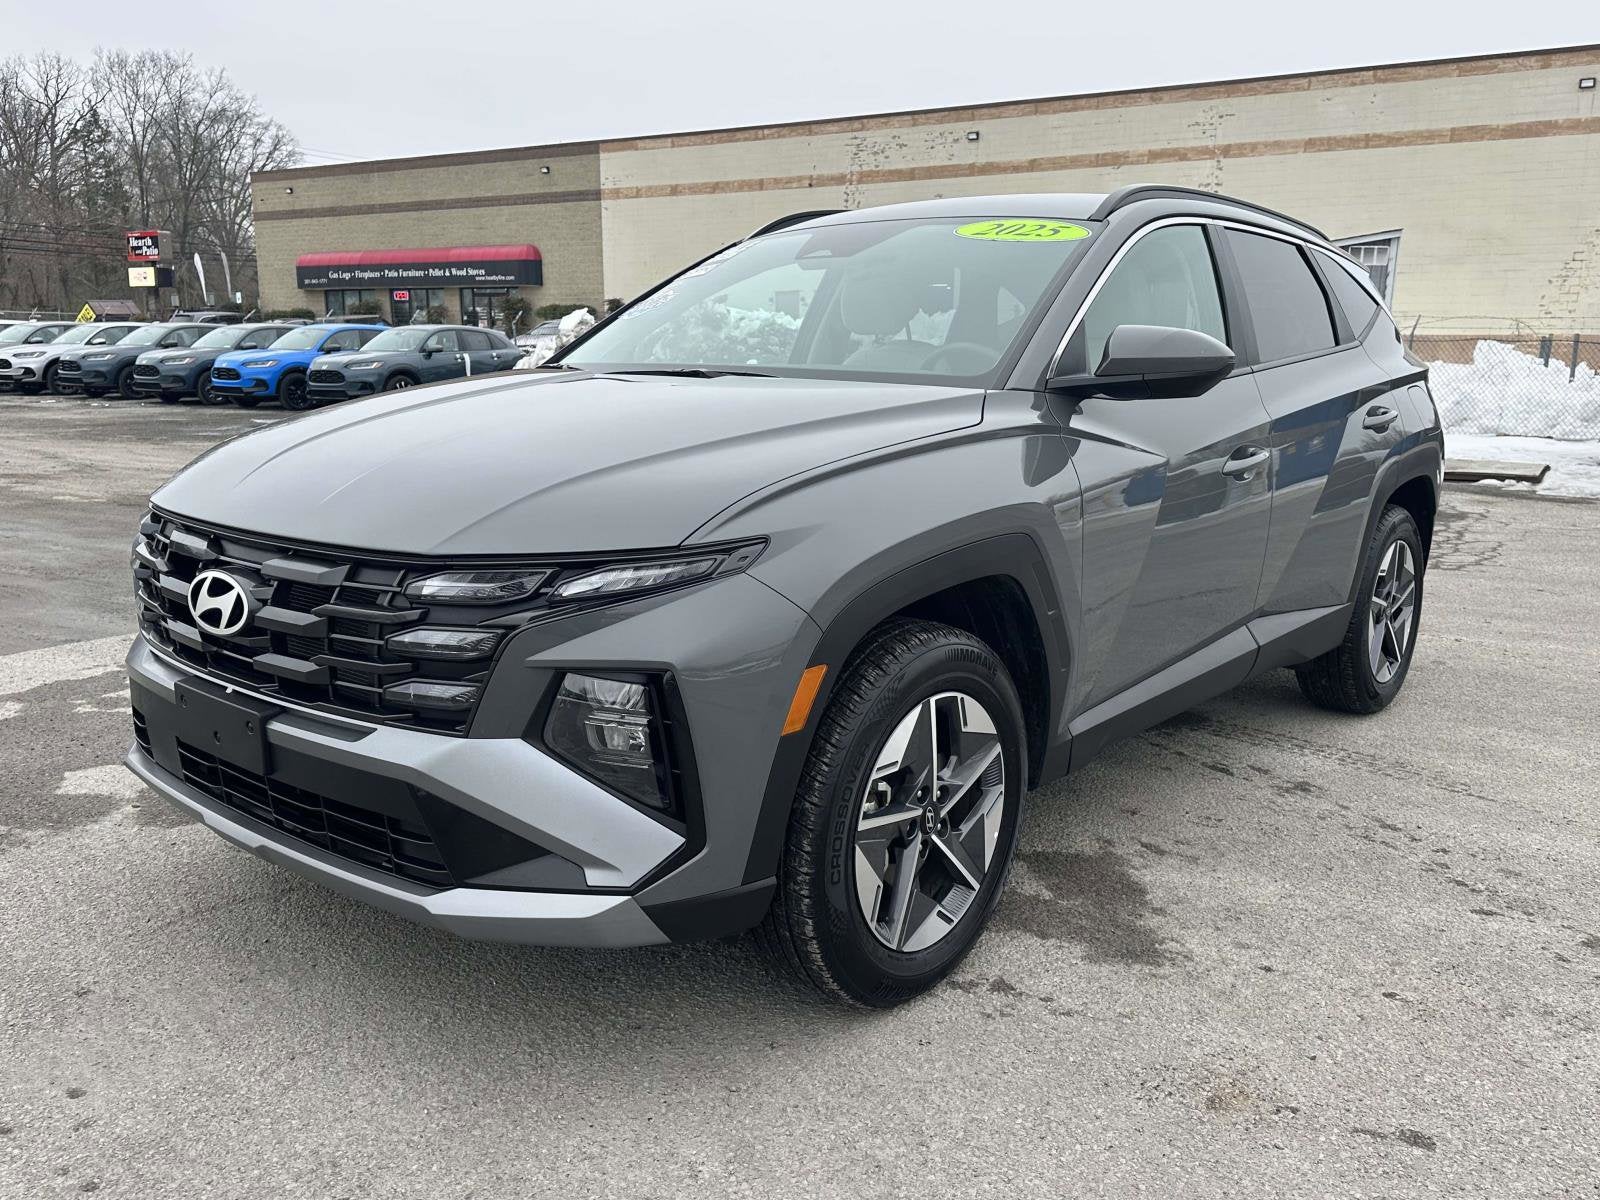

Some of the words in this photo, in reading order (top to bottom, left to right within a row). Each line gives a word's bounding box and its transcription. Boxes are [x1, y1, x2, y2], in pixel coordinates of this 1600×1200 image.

[970, 223, 1071, 237] 2025
[129, 236, 152, 247] Hearth
[142, 246, 159, 256] Patio
[328, 270, 339, 279] Gas
[339, 270, 351, 280] Logs
[355, 269, 380, 280] Fireplaces
[384, 269, 398, 278] Patio
[399, 268, 424, 277] Furniture
[428, 268, 444, 277] Pellet
[445, 268, 450, 277] &
[451, 267, 467, 276] Wood
[467, 267, 486, 276] Stoves
